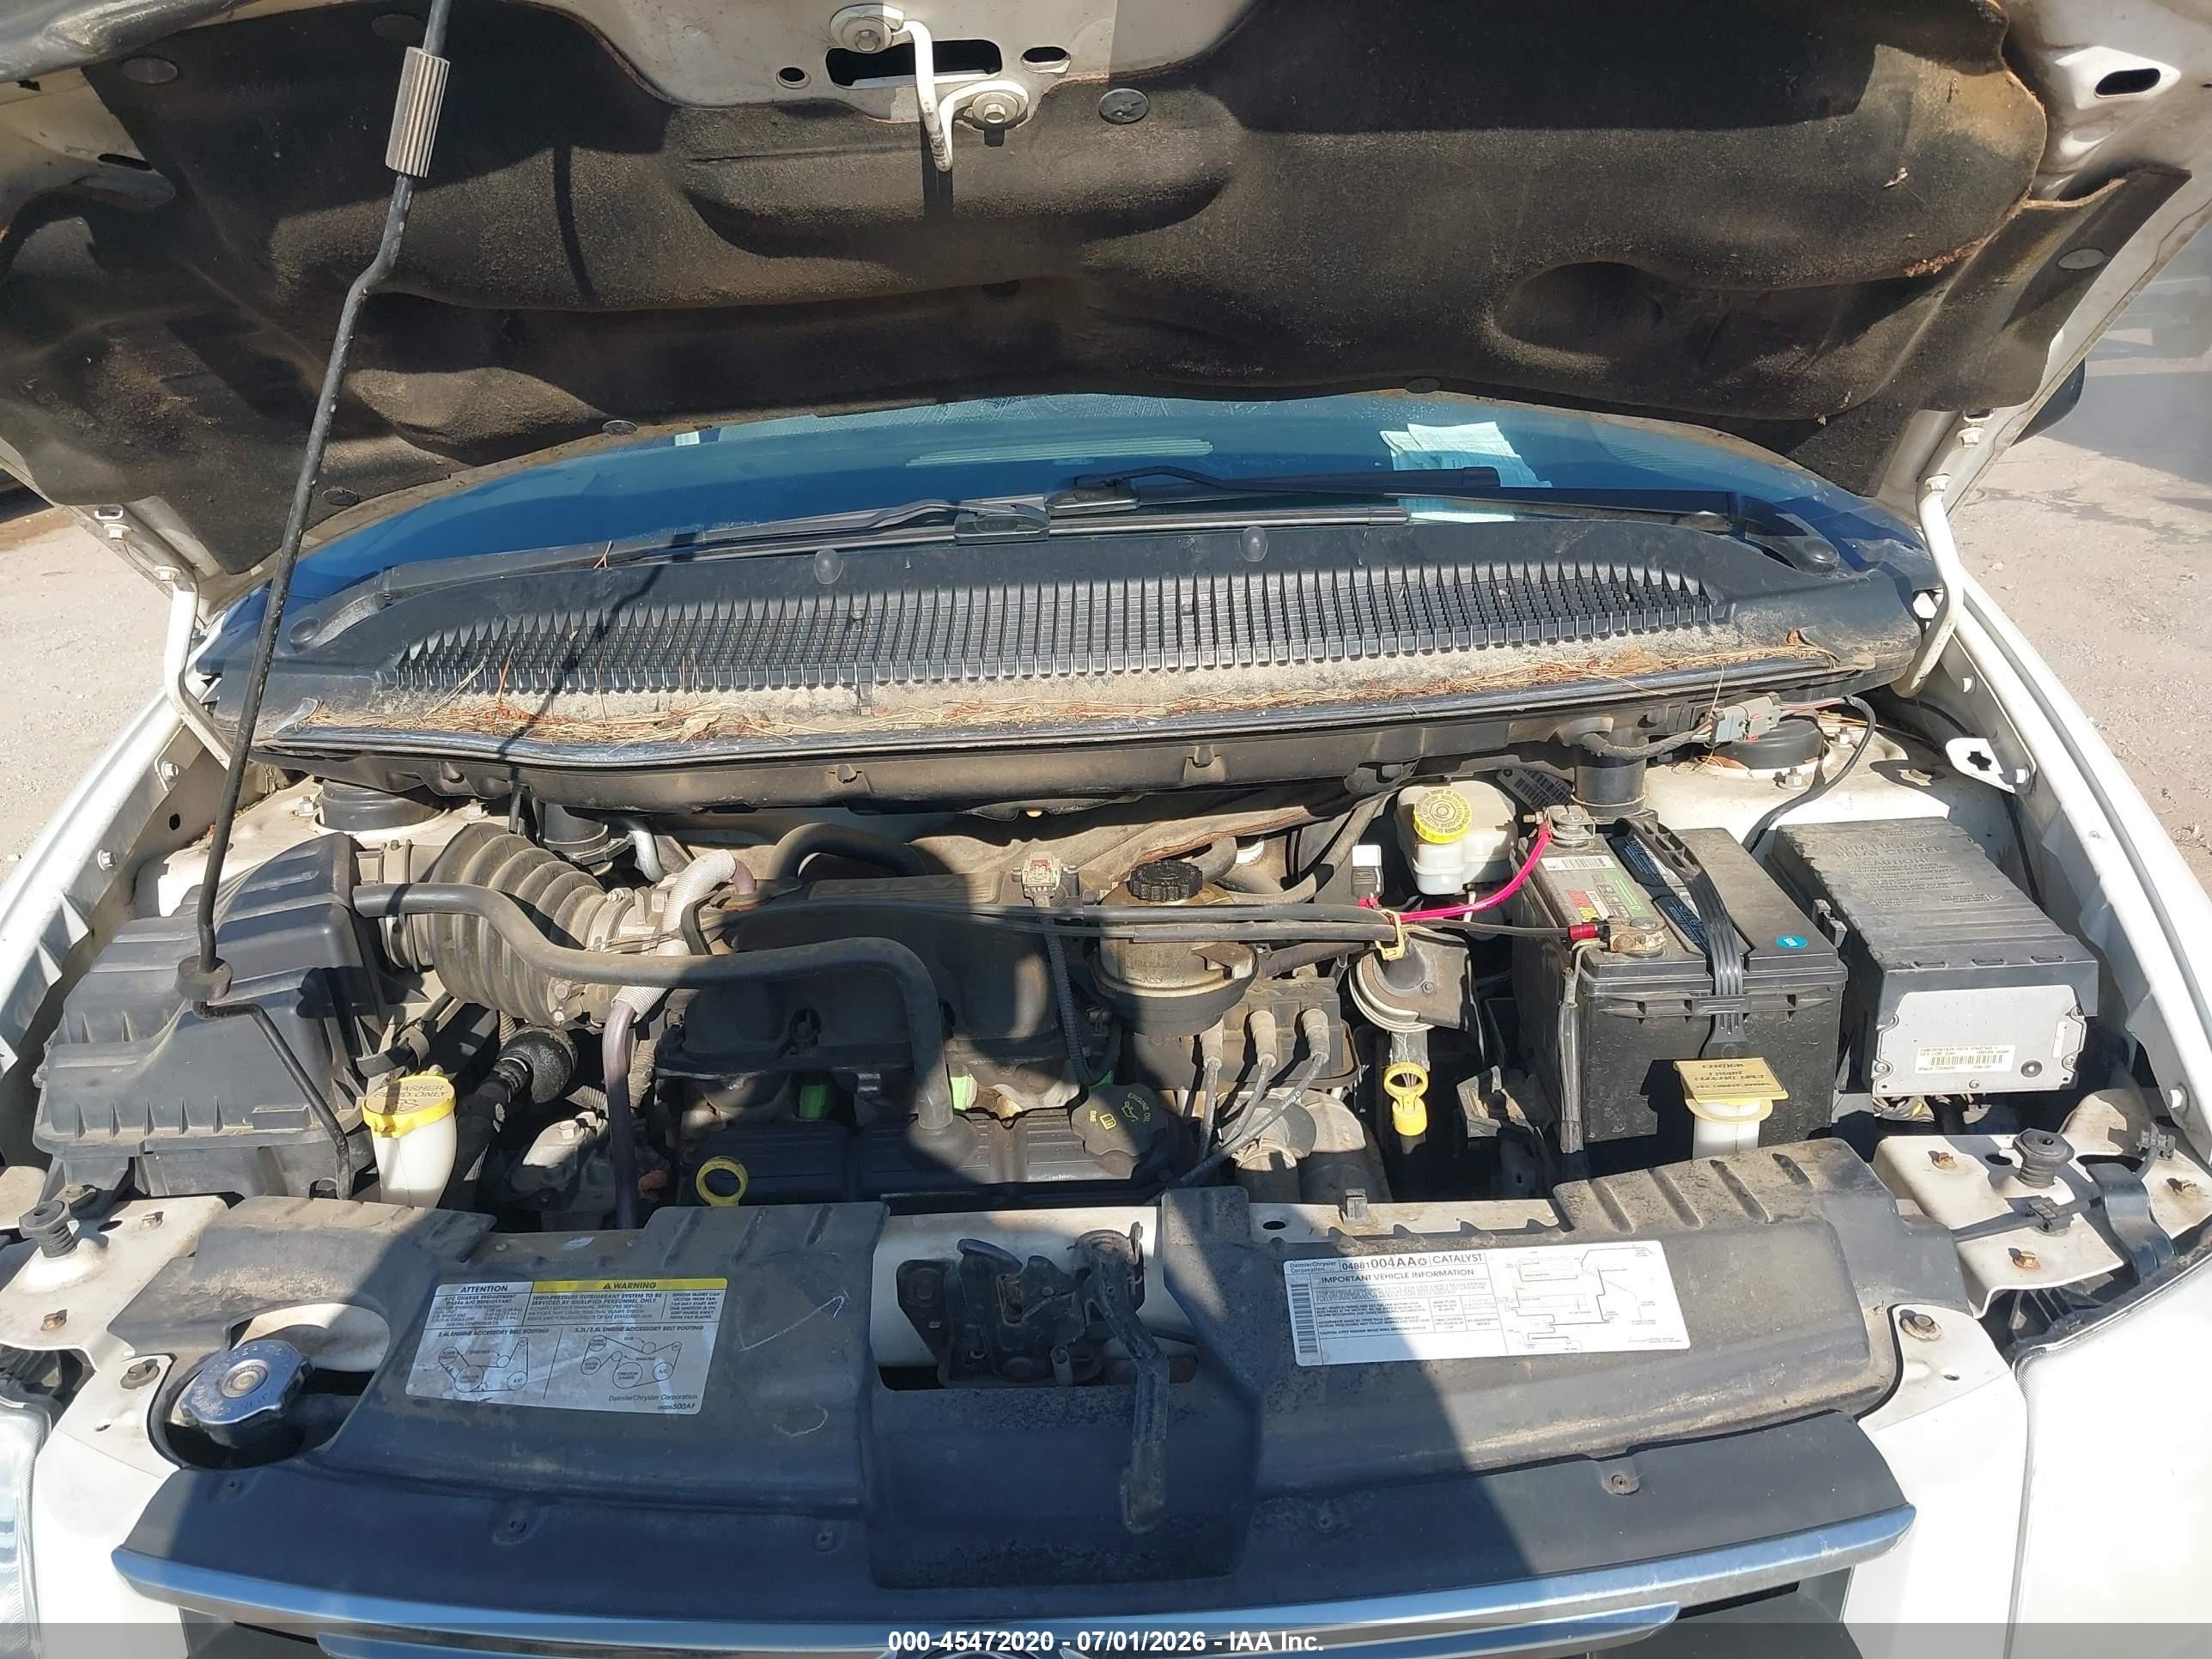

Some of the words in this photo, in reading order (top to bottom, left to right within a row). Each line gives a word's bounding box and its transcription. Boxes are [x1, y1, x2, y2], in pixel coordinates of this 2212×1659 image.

[1127, 1092, 1151, 1111] ENGINE
[1142, 1112, 1152, 1123] OIL
[1432, 1253, 1484, 1264] CATALYST
[1321, 1274, 1372, 1285] IMPORTANT
[1373, 1272, 1411, 1281] VEHICLE
[1412, 1268, 1475, 1279] INFORMATION
[609, 1394, 659, 1402] DaimlerChrysler
